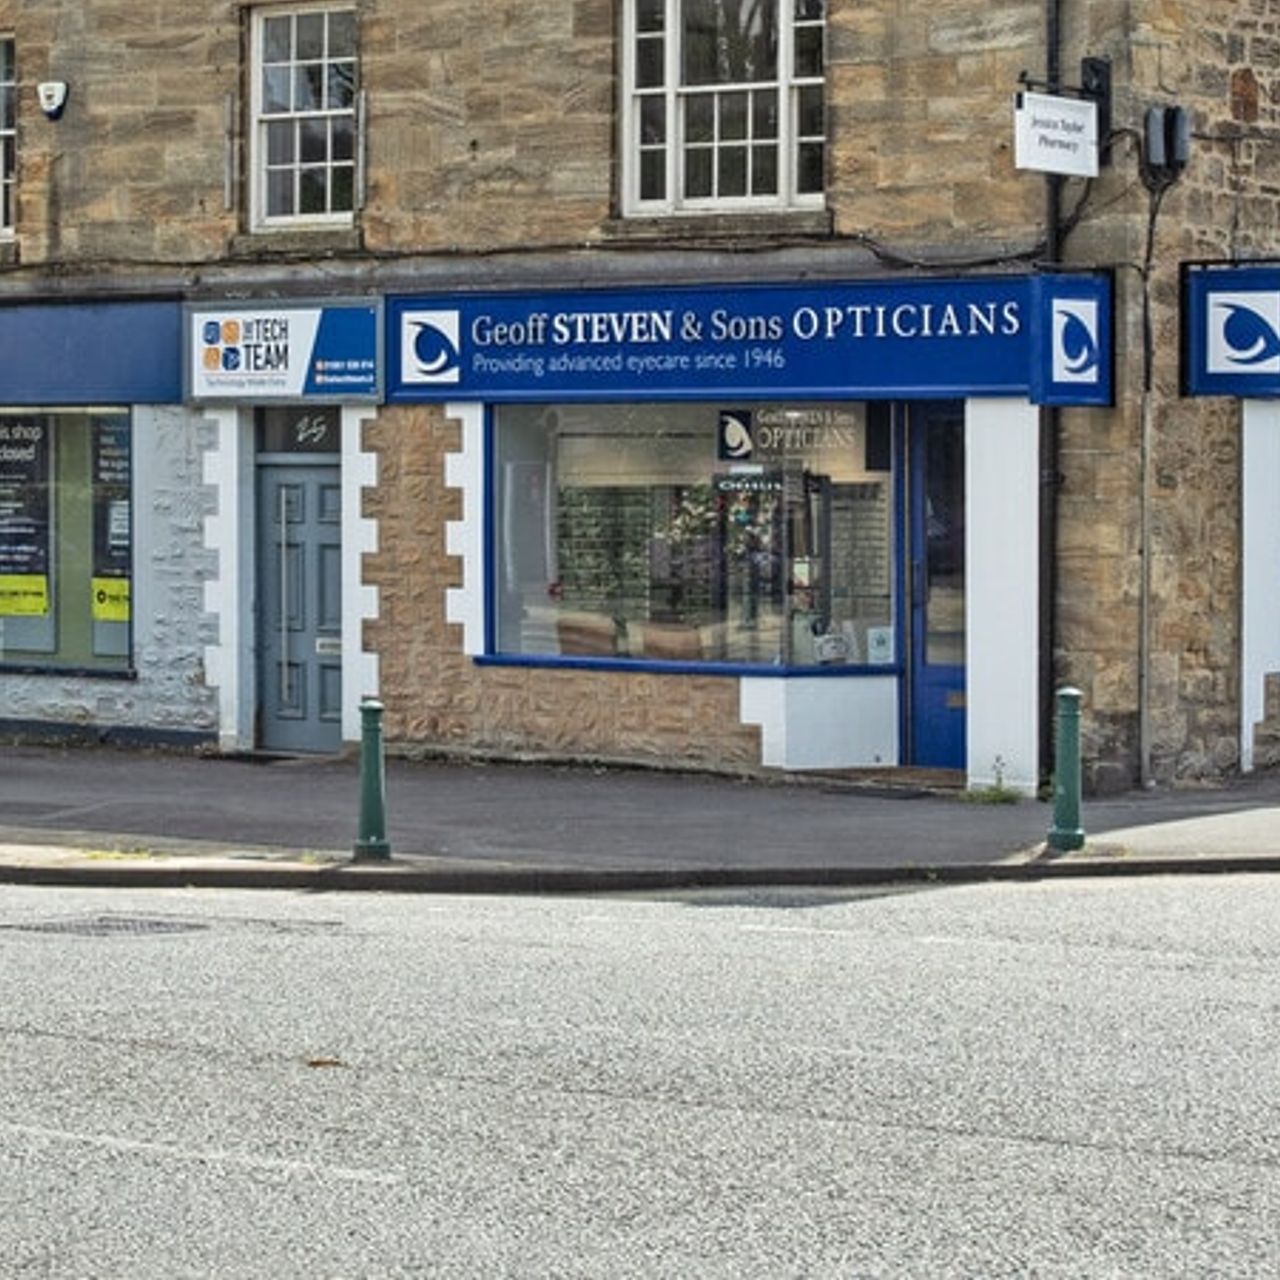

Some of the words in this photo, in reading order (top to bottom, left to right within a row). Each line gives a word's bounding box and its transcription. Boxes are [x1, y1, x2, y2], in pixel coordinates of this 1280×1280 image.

[255, 319, 289, 342] TECH
[472, 313, 549, 346] Geoff
[552, 310, 673, 344] STEVEN
[680, 310, 702, 341] &
[710, 308, 783, 340] Sons
[792, 301, 1020, 340] OPTICIANS
[243, 343, 289, 371] TEAM
[472, 352, 544, 376] Providing
[548, 350, 621, 371] advanced
[626, 351, 690, 374] eyecare
[694, 350, 737, 369] since
[744, 347, 785, 368] 1946
[11, 423, 42, 442] shop
[757, 426, 855, 449] OPTICIANS
